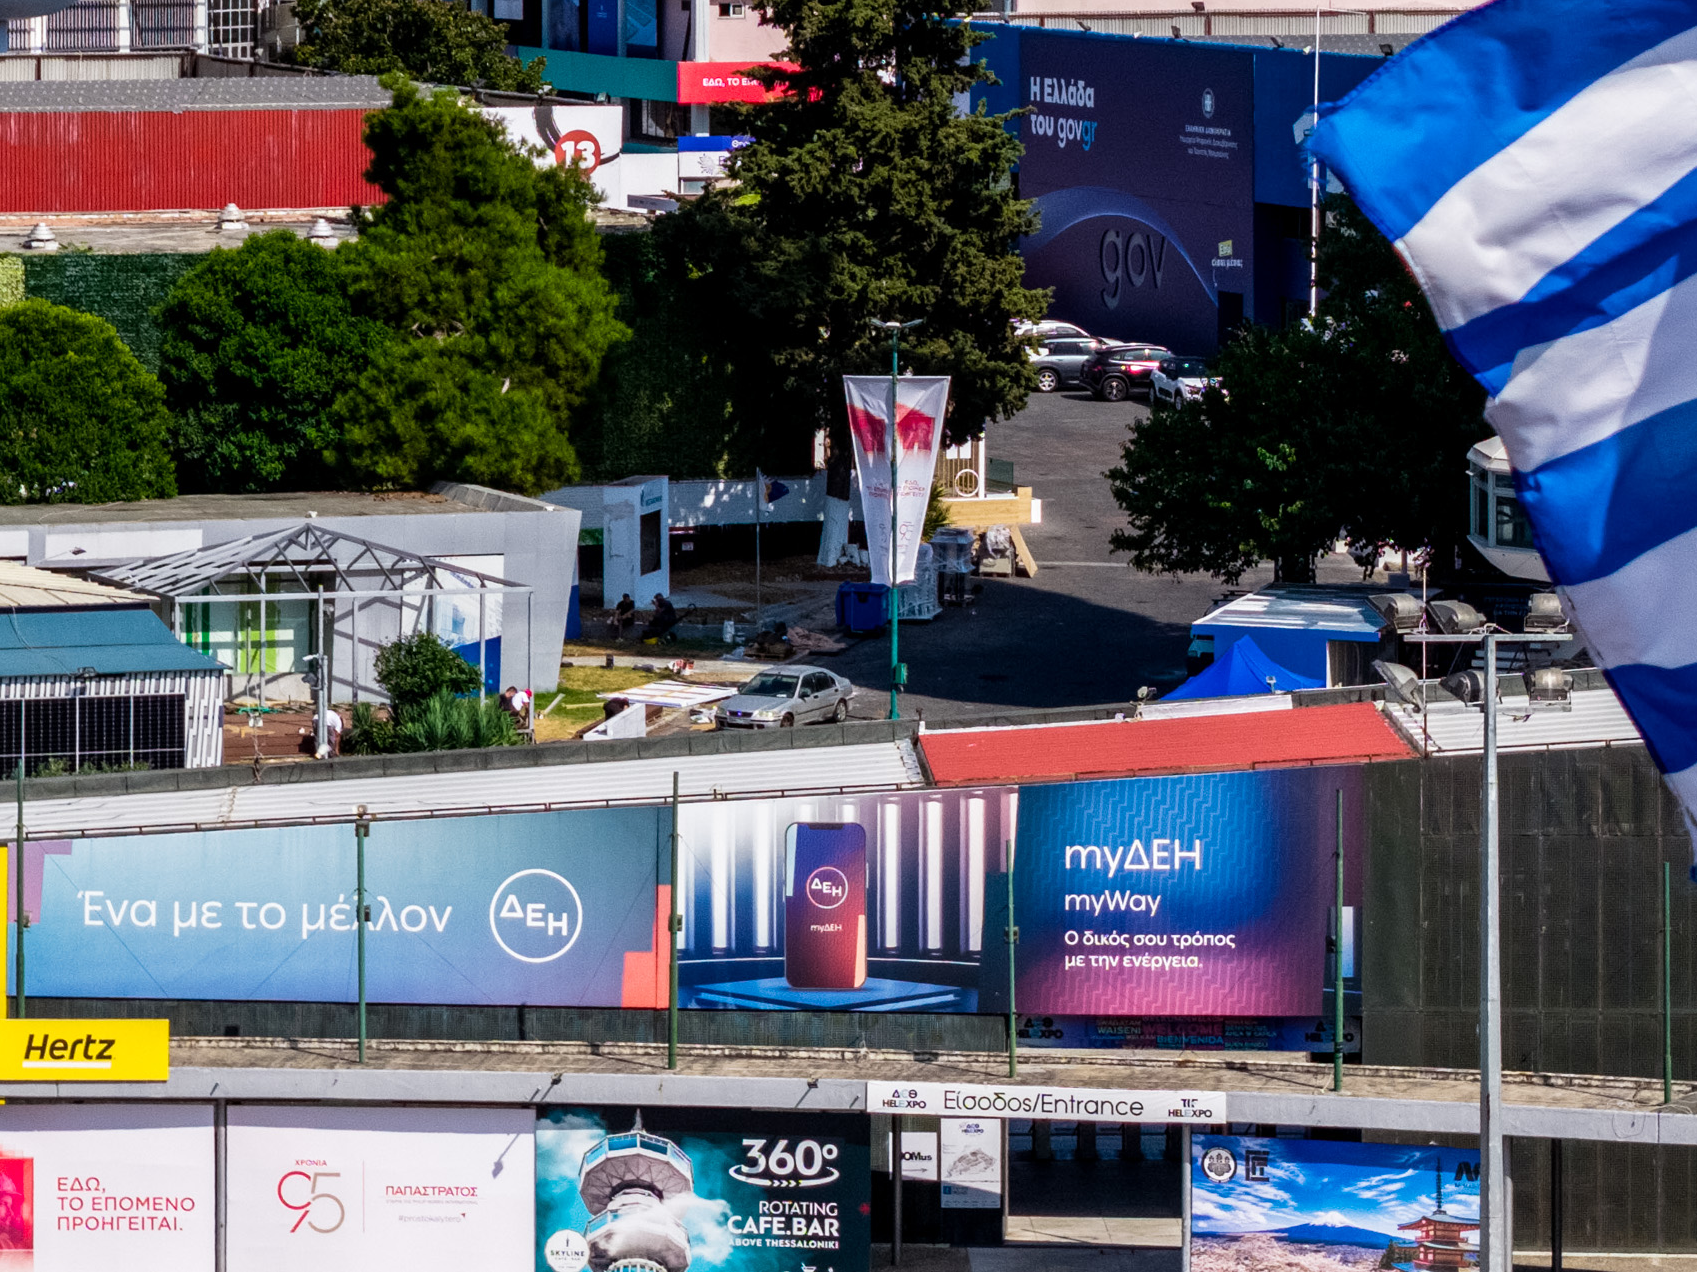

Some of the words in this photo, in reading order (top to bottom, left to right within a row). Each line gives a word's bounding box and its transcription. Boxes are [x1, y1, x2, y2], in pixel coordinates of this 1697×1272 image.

[1030, 76, 1041, 101] Η
[1044, 77, 1095, 108] Ελλάδα
[1030, 114, 1054, 136] του
[560, 140, 596, 169] 13
[1100, 229, 1168, 310] gov
[811, 877, 843, 897] ΔΕΗ
[1065, 890, 1162, 916] myWay
[76, 889, 158, 928] Ένα
[173, 898, 223, 937] με
[235, 899, 287, 930] το
[499, 893, 569, 937] ΔΕΗ
[1082, 930, 1130, 949] δικός
[1133, 932, 1167, 946] σου
[1170, 931, 1236, 949] τρόπος
[1064, 954, 1085, 970] με
[1088, 954, 1120, 970] την
[1122, 953, 1204, 971] ενέργεια.
[23, 1033, 117, 1060] Hertz
[1156, 1035, 1224, 1045] BIENVENIDA
[1306, 1032, 1355, 1043] HELEO
[882, 1099, 927, 1109] HELEXPO
[1168, 1108, 1213, 1118] HELEXPO
[295, 1159, 327, 1167] ΧΡΟΝΙΑ
[57, 1177, 107, 1194] ΕΔΩ,
[385, 1185, 478, 1198] ΠΑΠΑΣΤΡΑΤΟΣ
[57, 1197, 84, 1211] ΤΟ
[91, 1196, 196, 1211] ΕΠΟΜΕΝΟ
[277, 1170, 345, 1234] 95
[758, 1200, 838, 1216] ROTATING
[57, 1216, 184, 1232] ΠΡΟΗΓΕΙΤΑΙ.
[727, 1216, 840, 1237] CAFE.BAR
[729, 1238, 763, 1247] ABOVE
